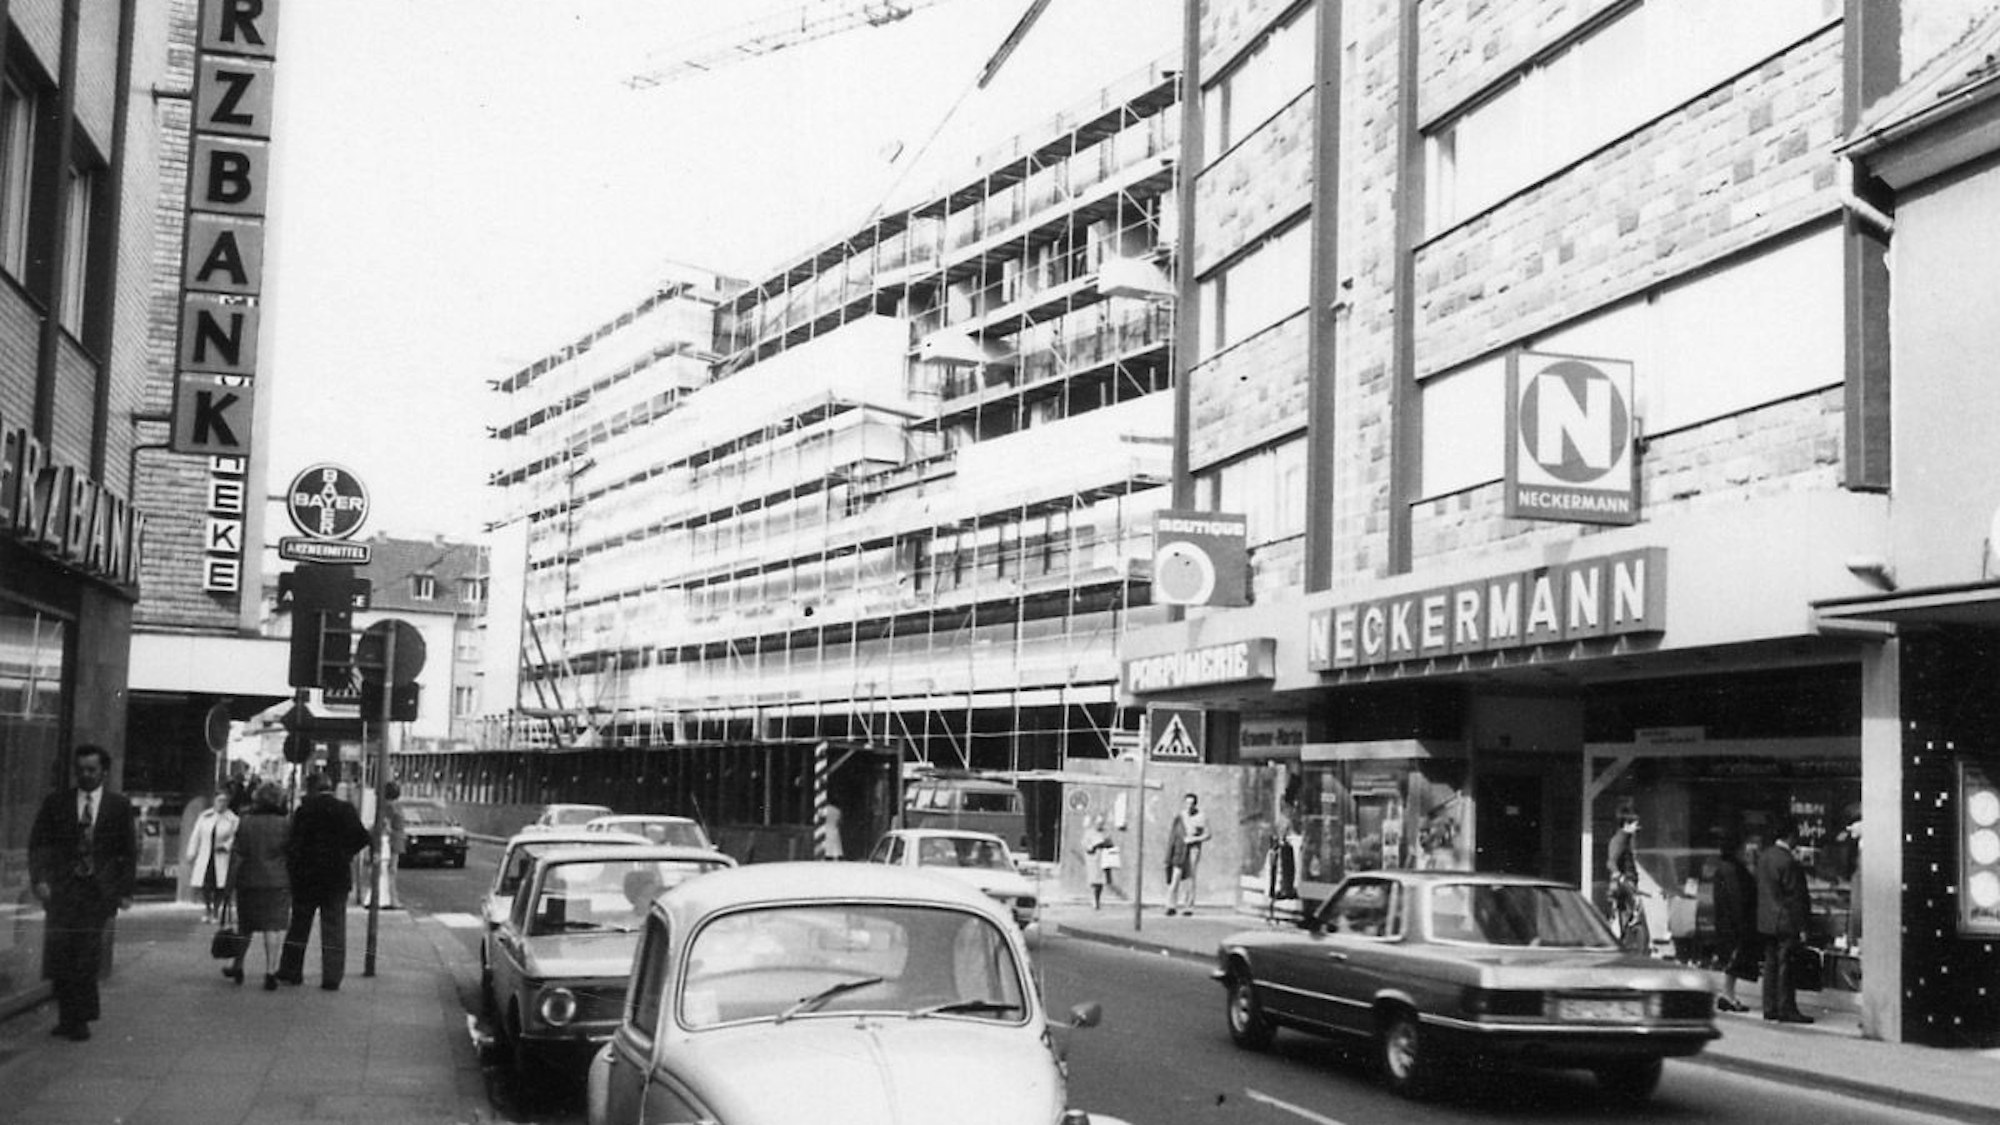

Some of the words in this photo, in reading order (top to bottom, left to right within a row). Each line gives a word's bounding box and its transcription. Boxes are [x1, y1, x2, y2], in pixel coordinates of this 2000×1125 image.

[193, 0, 266, 447] RZBANK
[295, 492, 364, 511] BAYER
[1518, 491, 1630, 513] NECKERMANN
[1159, 518, 1245, 538] BOUTIQUE
[286, 542, 366, 559] ARZNEIMITTEL
[1309, 558, 1646, 662] NECKERMANN
